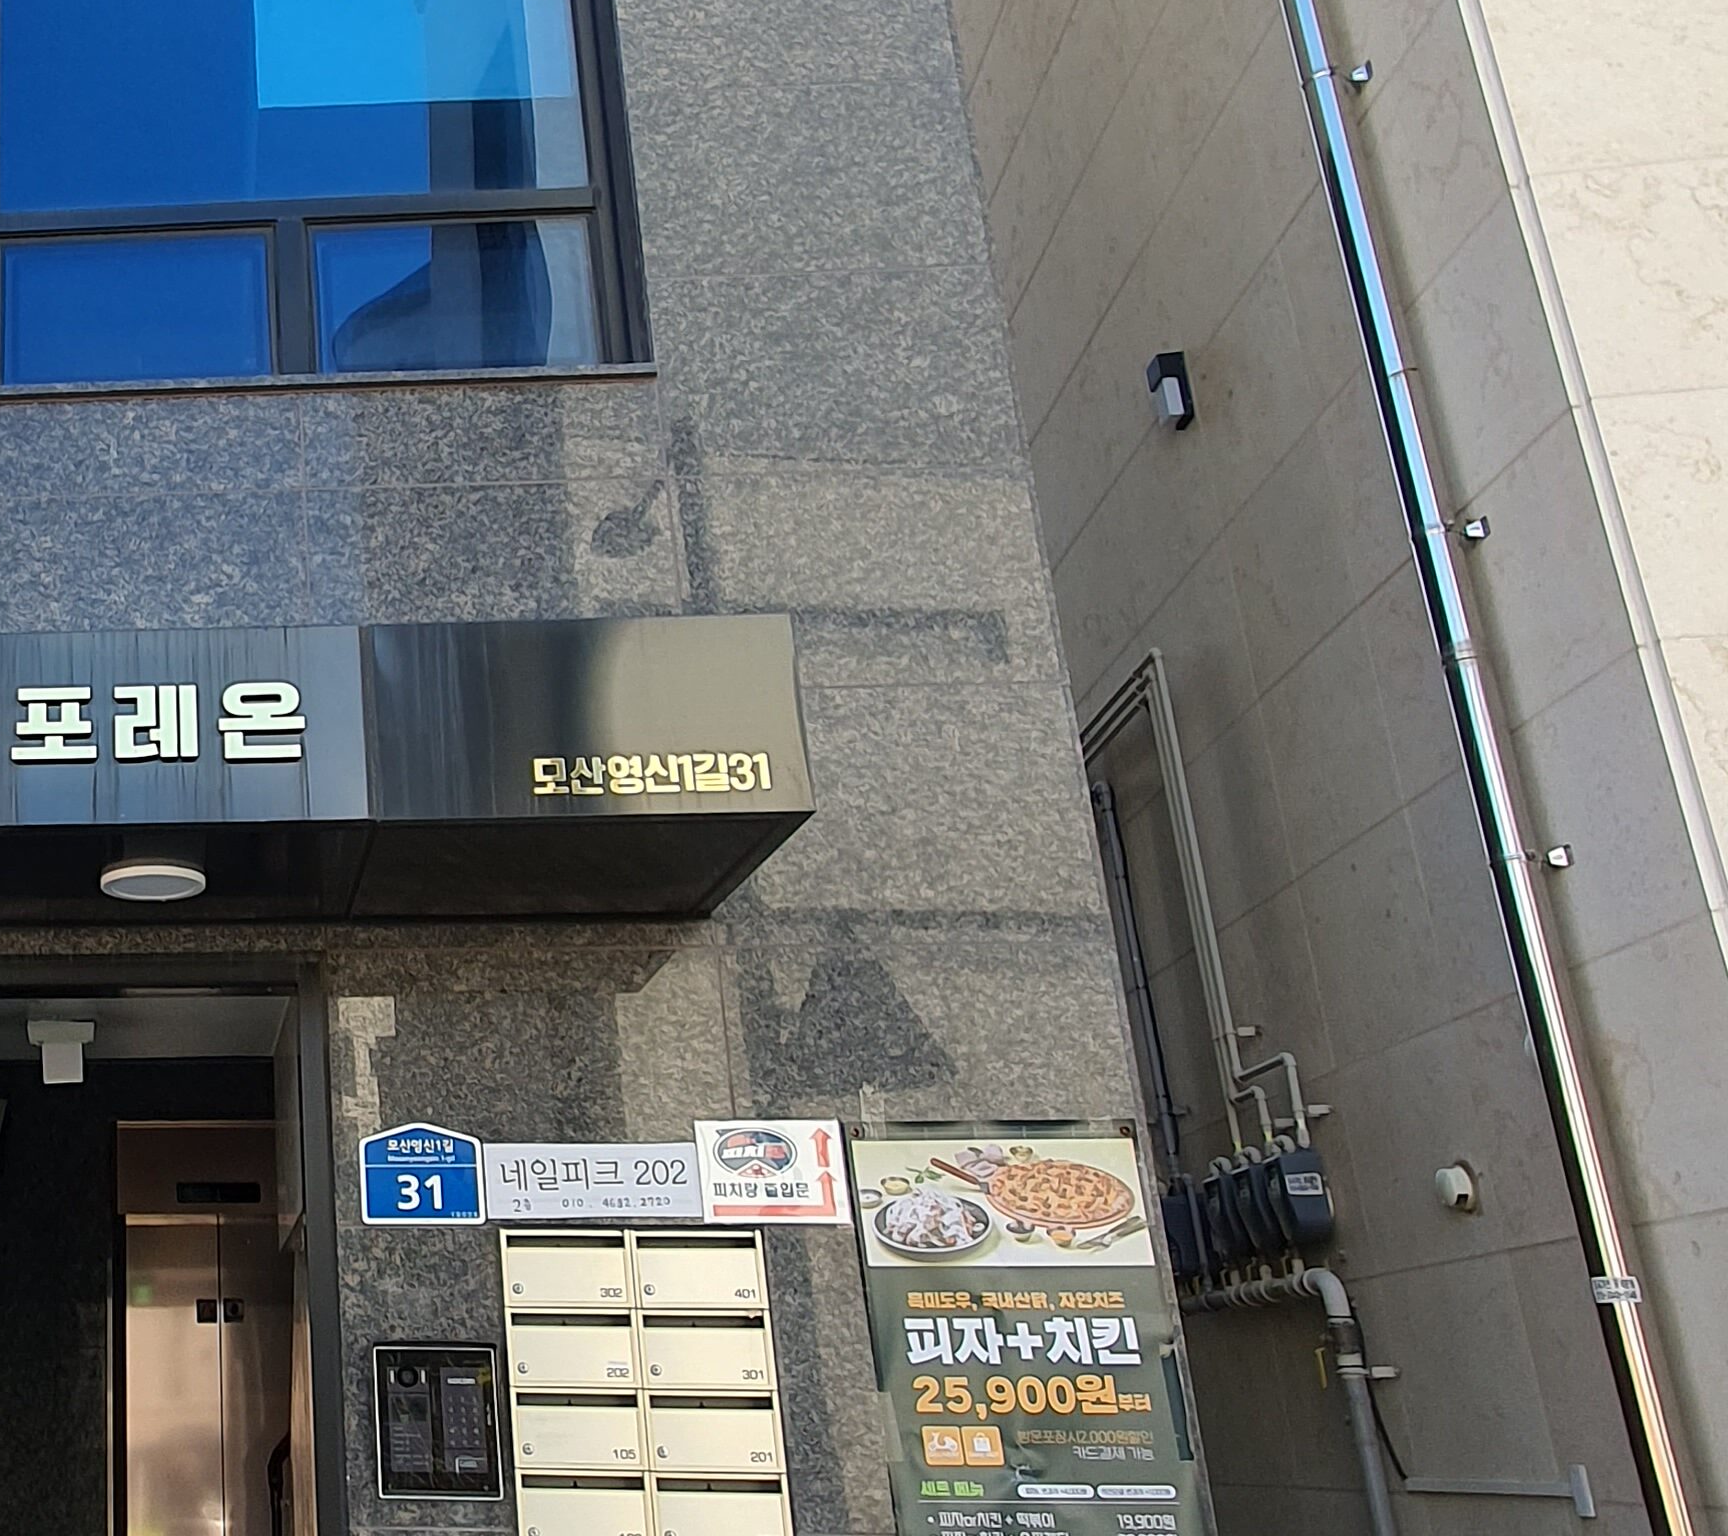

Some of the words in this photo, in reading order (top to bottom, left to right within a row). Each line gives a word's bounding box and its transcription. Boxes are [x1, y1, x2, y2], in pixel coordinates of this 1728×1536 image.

[10, 681, 308, 764] 포레온
[532, 752, 773, 795] 모산영신1길31
[499, 1158, 624, 1191] 네일피크
[634, 1159, 688, 1186] 202
[397, 1174, 443, 1211] 31
[600, 1287, 623, 1298] 302
[734, 1288, 757, 1299] 401
[1059, 1292, 1125, 1310] 자연치즈
[903, 1316, 1142, 1365] 피자+치킨
[607, 1367, 630, 1378] 202
[742, 1369, 765, 1380] 301
[612, 1449, 637, 1460] 105
[750, 1451, 773, 1462] 201
